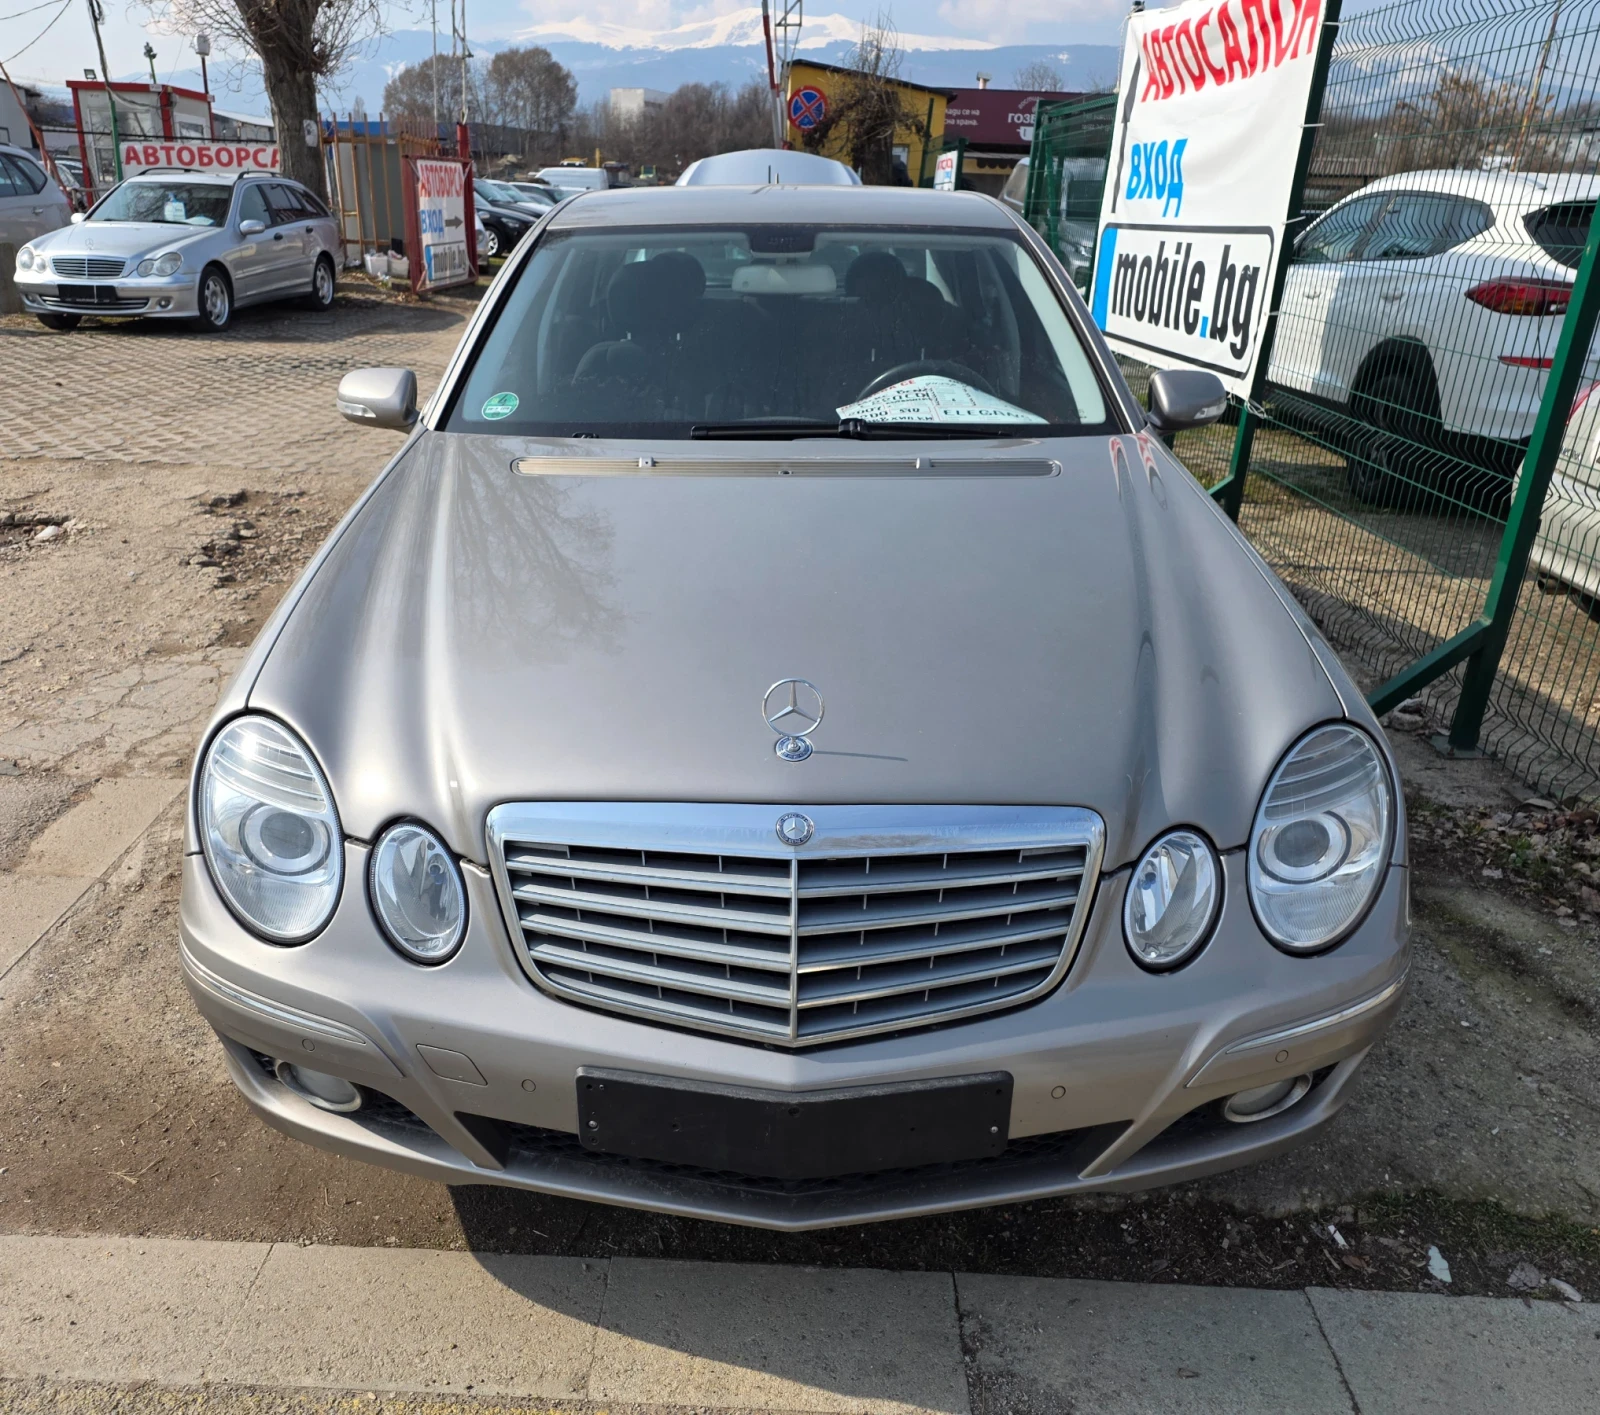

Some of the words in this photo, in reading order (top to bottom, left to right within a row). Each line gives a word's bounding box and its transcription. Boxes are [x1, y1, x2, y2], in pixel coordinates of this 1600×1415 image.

[1126, 138, 1188, 217] ВХОД
[420, 209, 445, 238] ВХОД
[433, 244, 467, 274] mobile.bg
[1112, 241, 1260, 360] mobile.bg
